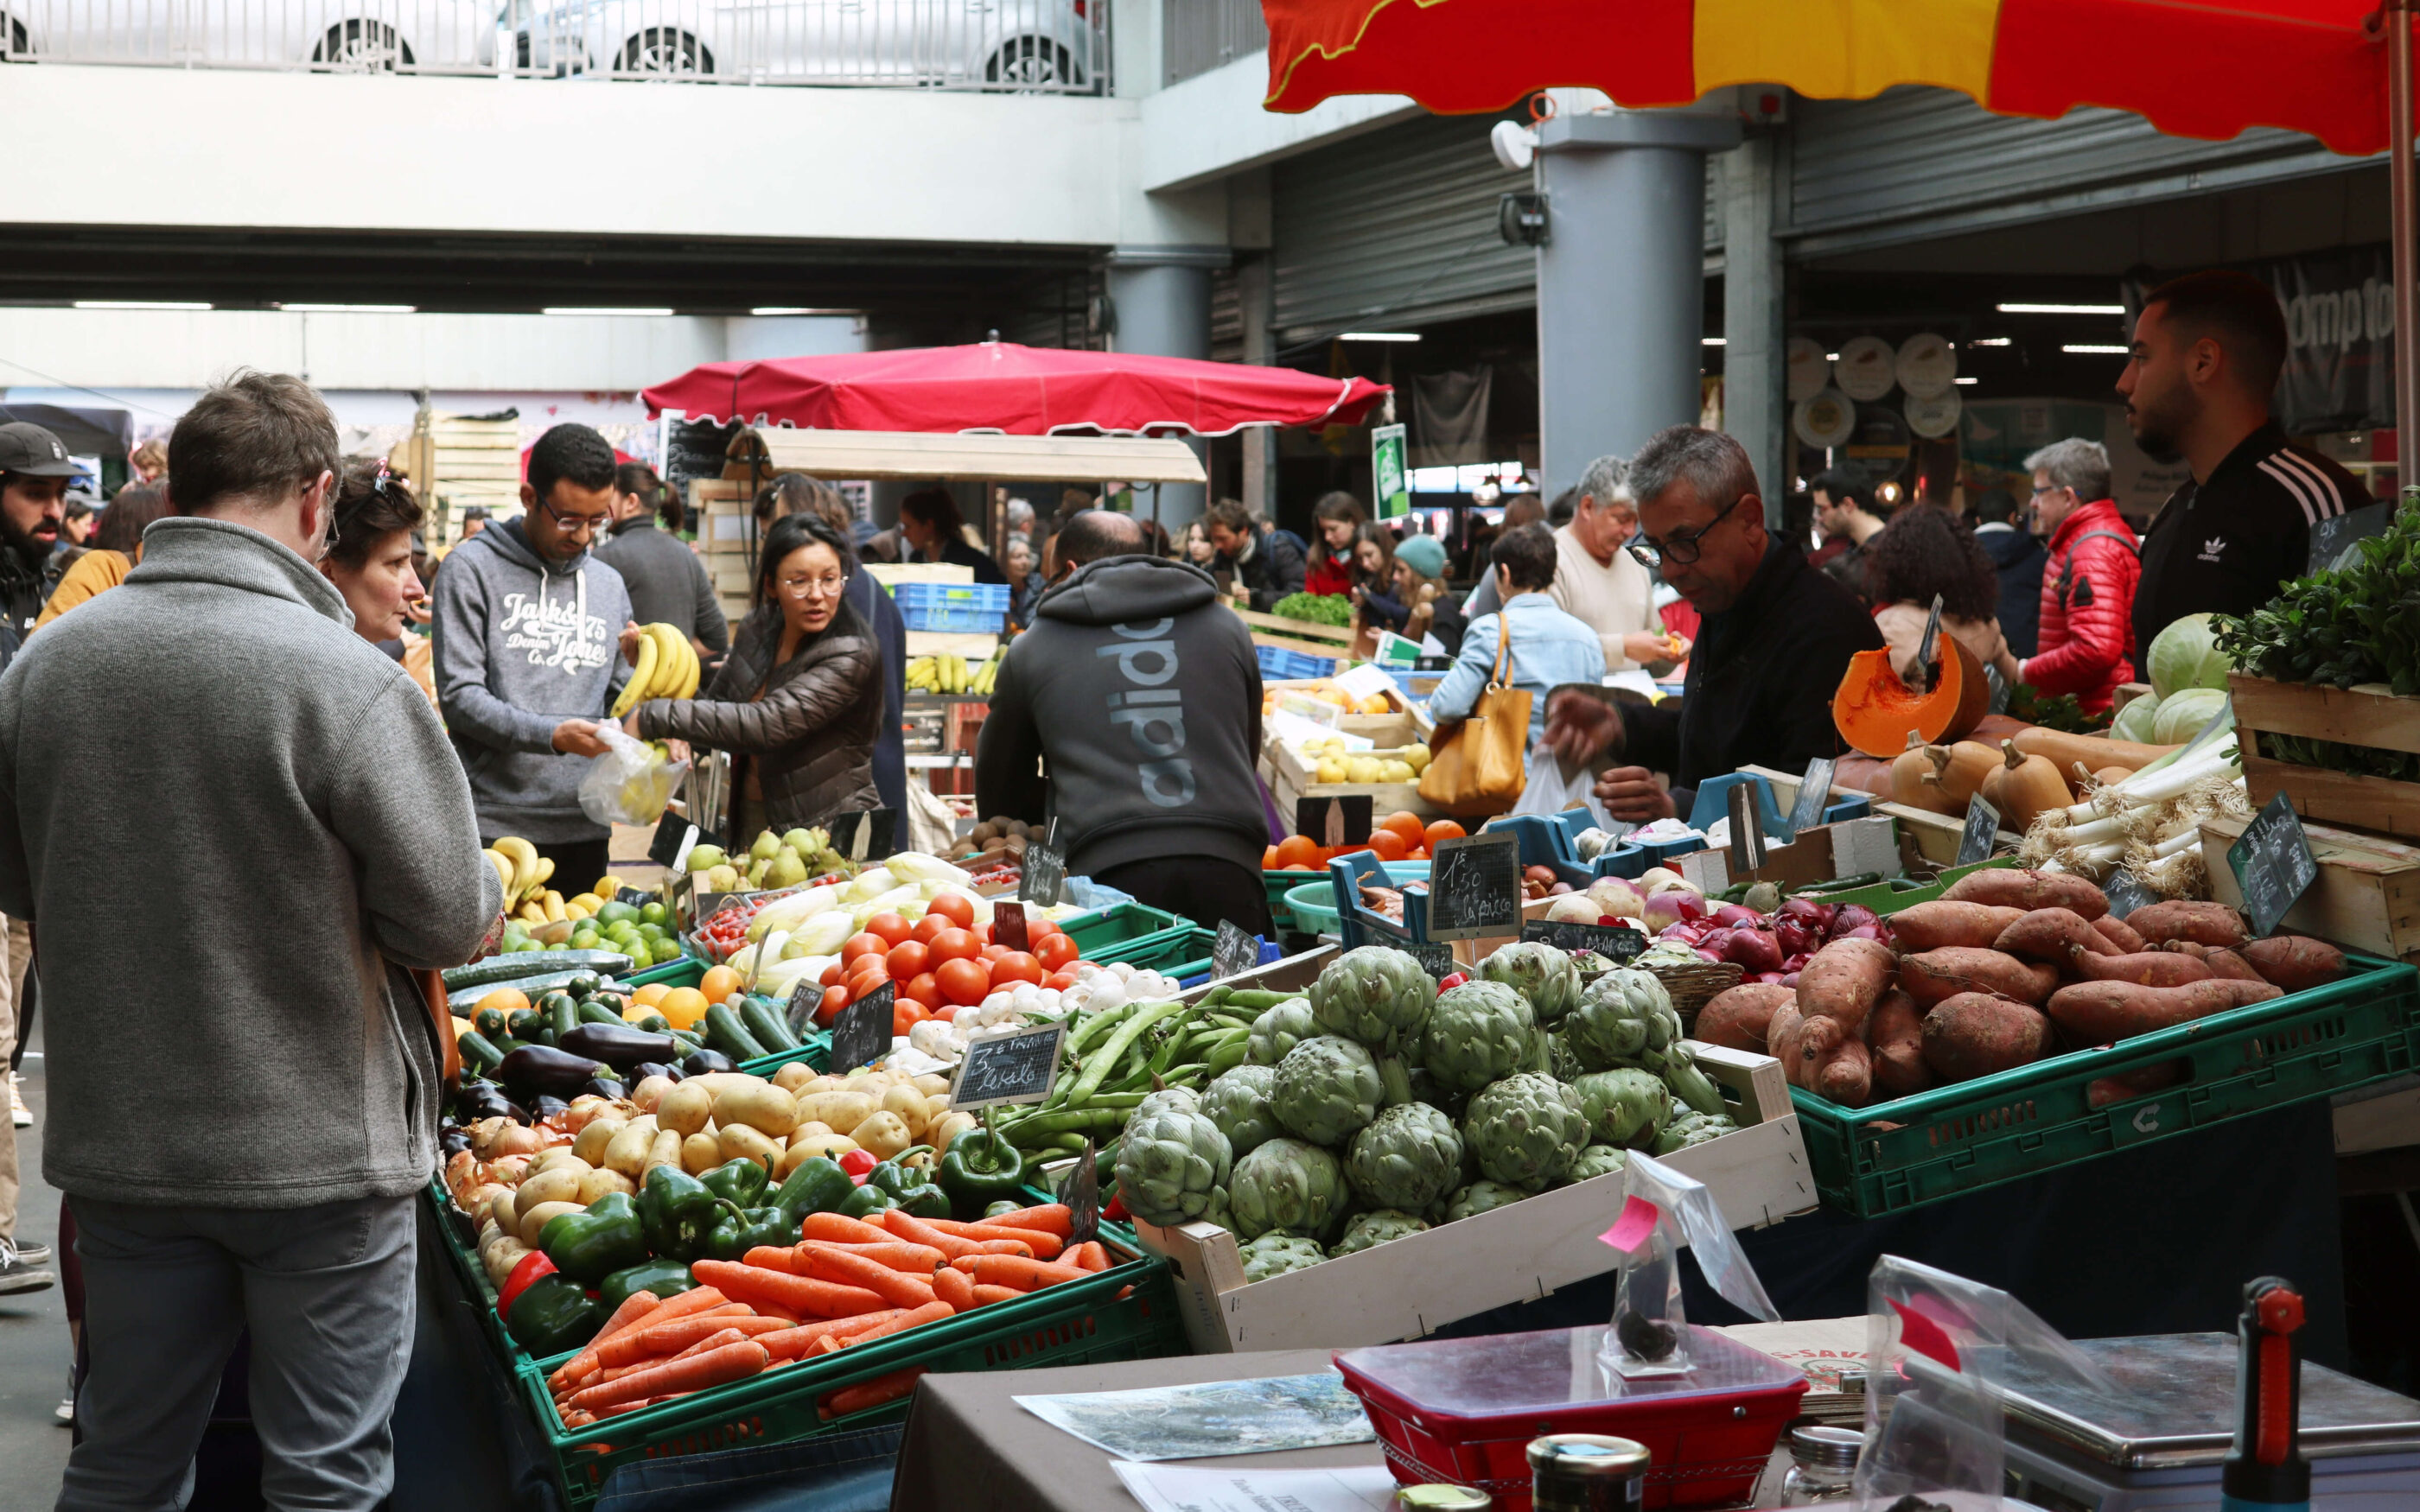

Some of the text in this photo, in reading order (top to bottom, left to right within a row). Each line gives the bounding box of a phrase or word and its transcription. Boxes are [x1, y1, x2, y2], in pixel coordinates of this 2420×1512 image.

[2289, 278, 2395, 353] ompto
[506, 632, 551, 650] Denim
[585, 615, 607, 641] 75
[2246, 830, 2262, 857] Origine
